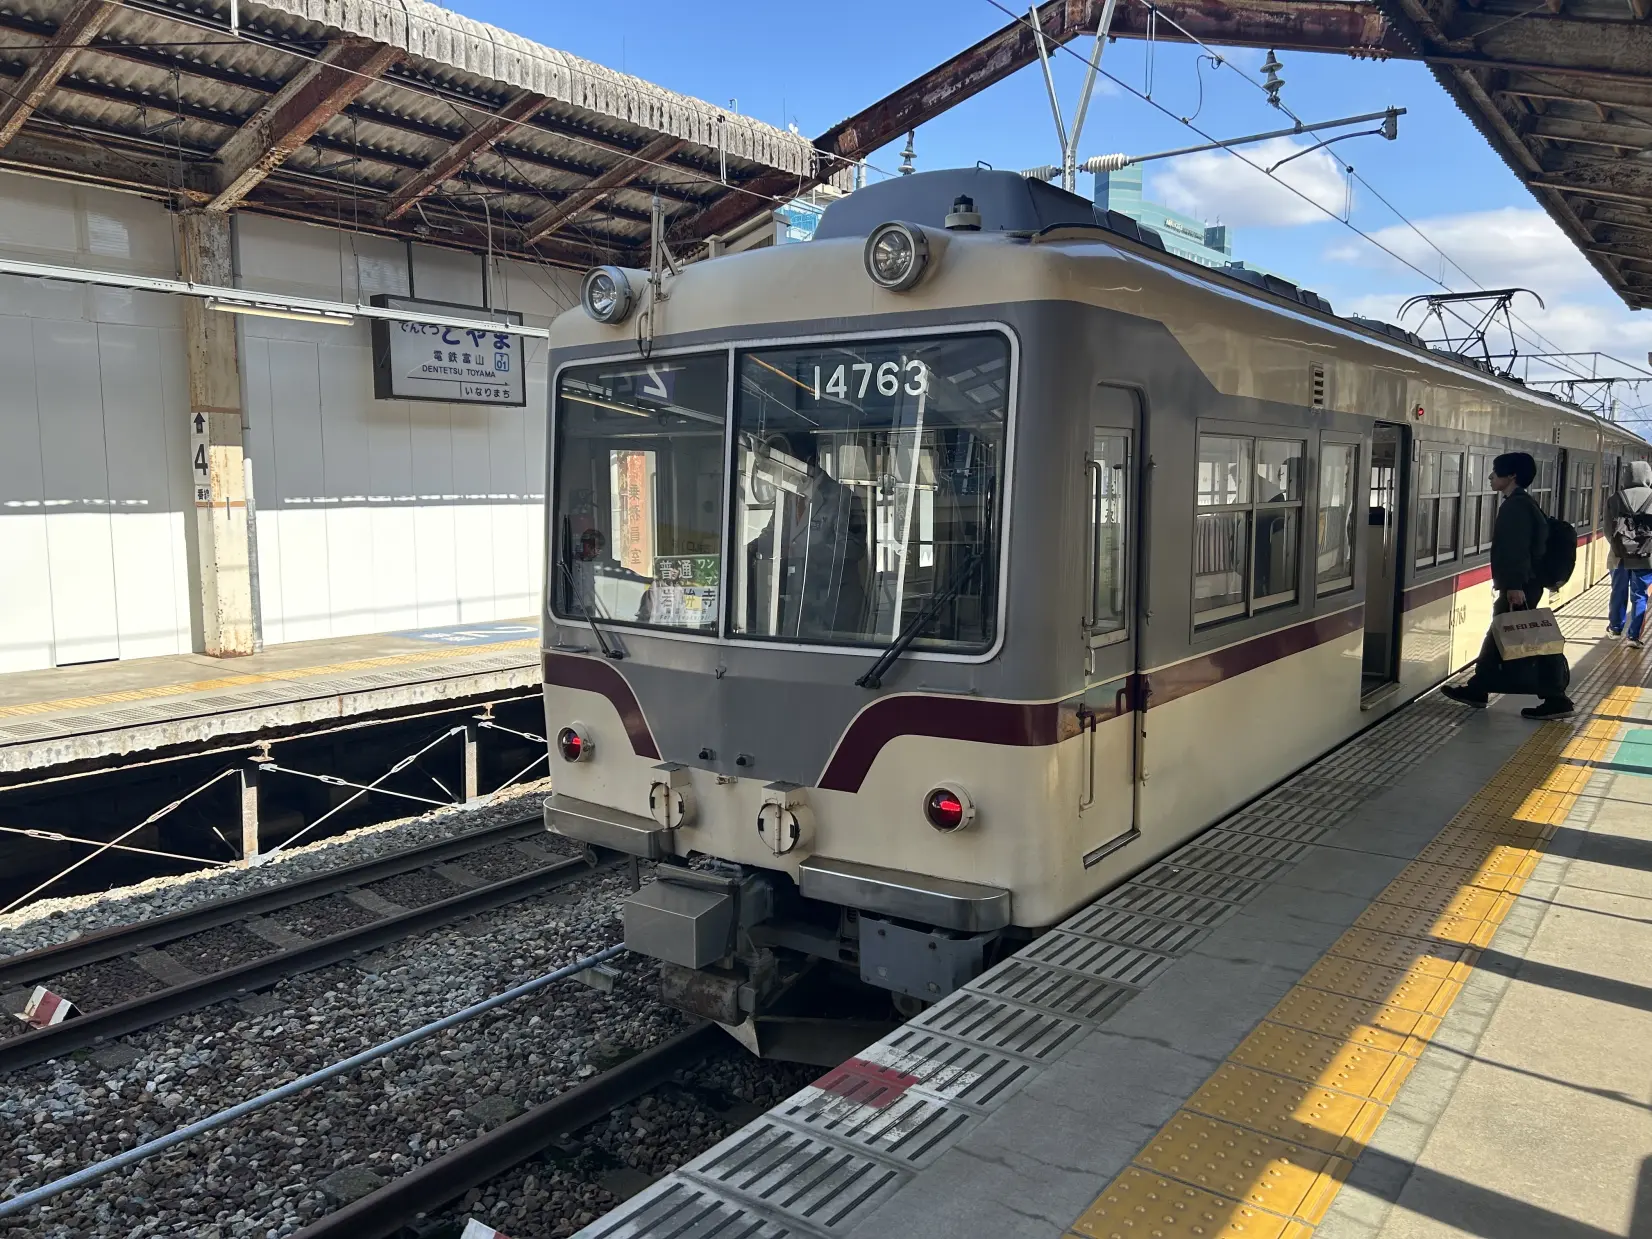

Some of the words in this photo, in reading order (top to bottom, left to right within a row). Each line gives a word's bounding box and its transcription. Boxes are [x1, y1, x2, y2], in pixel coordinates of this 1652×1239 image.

[433, 350, 485, 366] 電鉄富山
[496, 360, 507, 370] 01
[422, 364, 463, 376] DENTETSU
[467, 369, 496, 378] TOYAMA
[814, 359, 928, 401] 14763
[465, 386, 510, 399] いなりまち
[194, 443, 209, 476] 4
[659, 559, 693, 580] 普通
[697, 559, 715, 569] ワン
[1502, 619, 1553, 633] 無印良品
